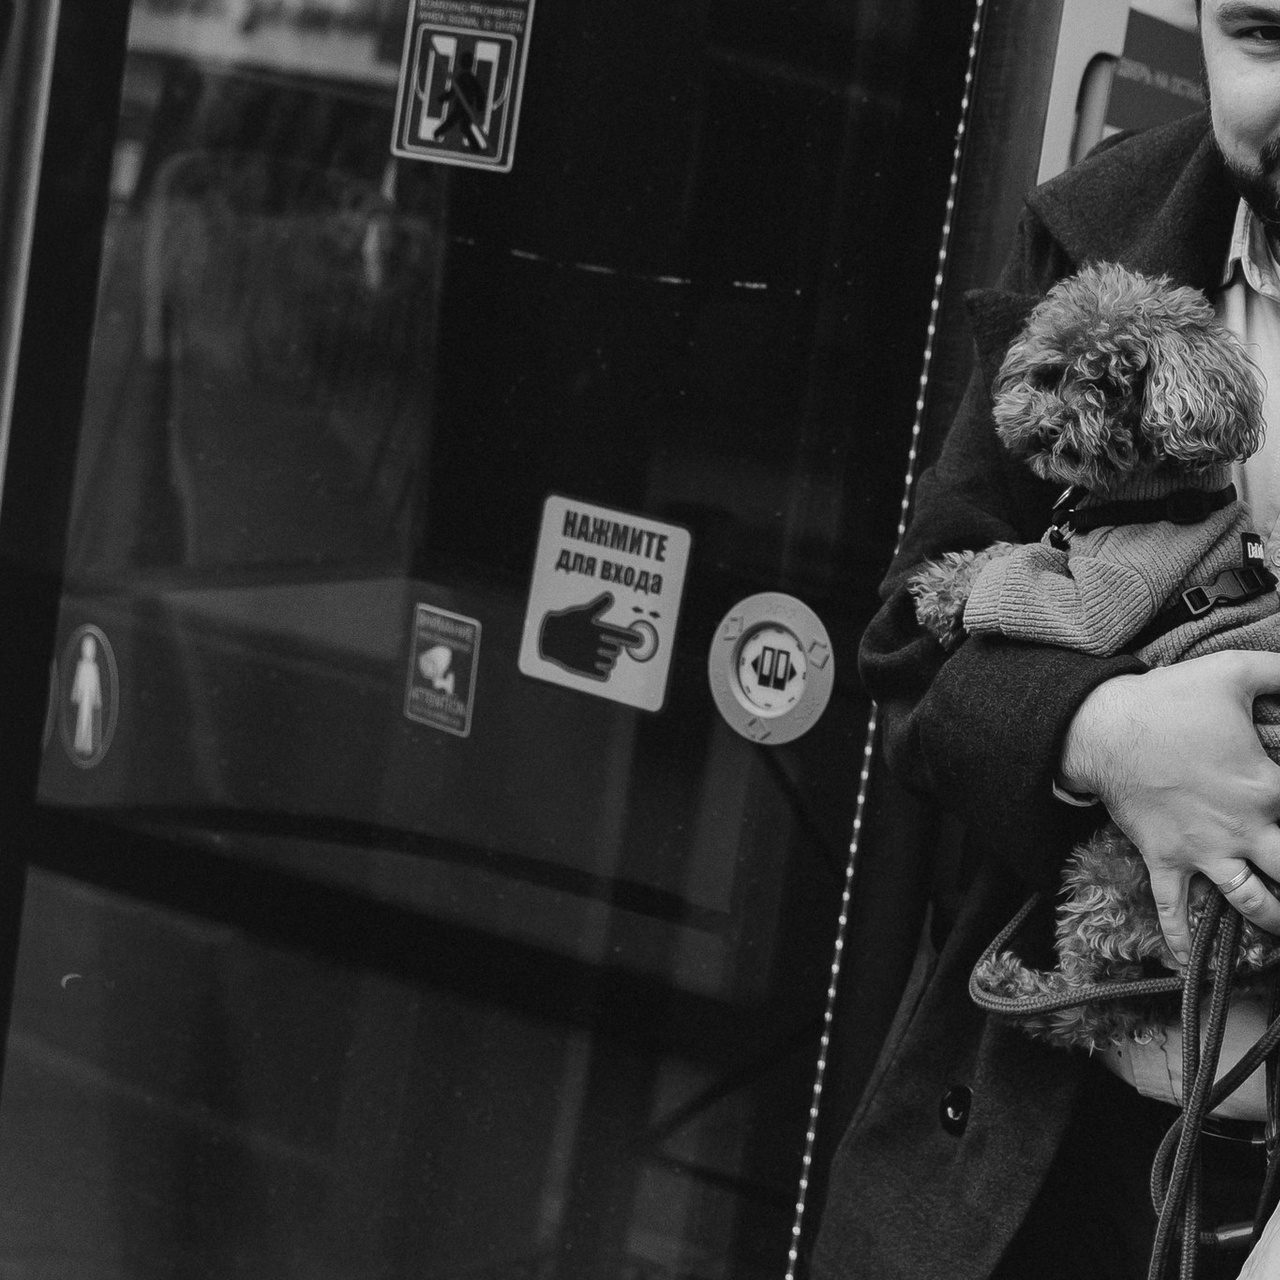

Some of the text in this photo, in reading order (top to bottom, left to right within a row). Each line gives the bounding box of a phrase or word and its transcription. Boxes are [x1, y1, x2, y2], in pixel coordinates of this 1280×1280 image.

[562, 510, 669, 562] НАЖМИТЕ
[555, 548, 664, 595] для входа
